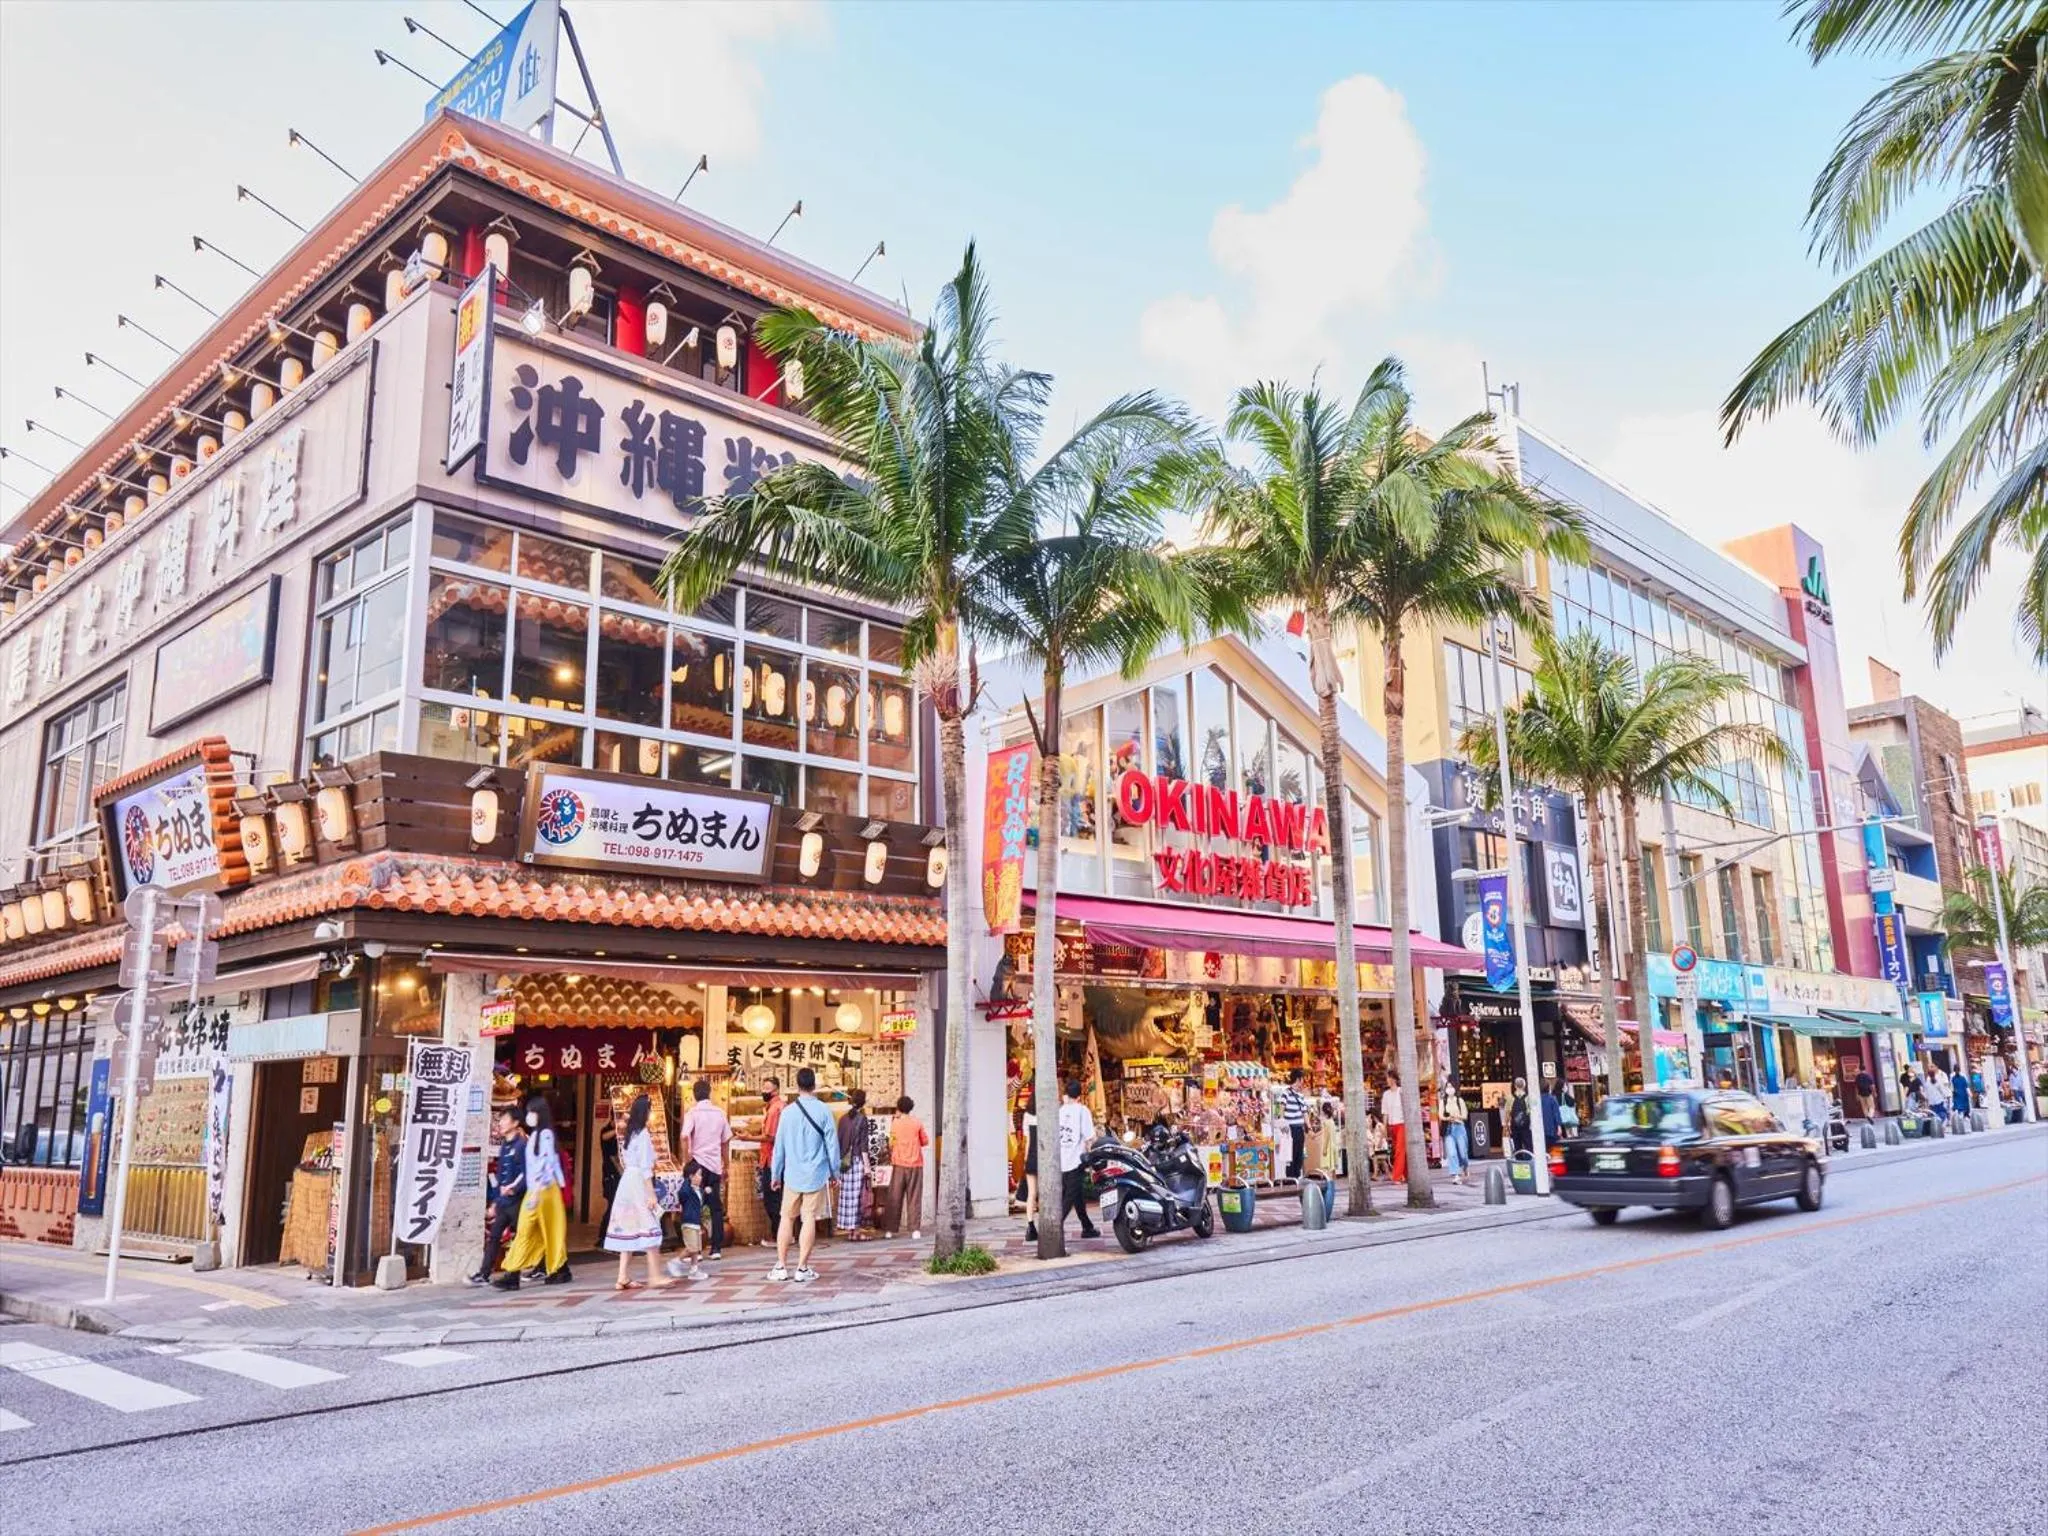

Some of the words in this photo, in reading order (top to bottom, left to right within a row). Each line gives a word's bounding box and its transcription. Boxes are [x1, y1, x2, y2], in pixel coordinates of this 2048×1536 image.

[588, 822, 629, 835] 沖縄料理
[590, 807, 619, 822] 島唄と
[632, 802, 760, 852] ちぬまん
[1000, 752, 1029, 860] OKINAWA
[1115, 769, 1330, 855] OKINAWA
[1153, 844, 1312, 907] 文化屋雑貨店
[418, 1048, 470, 1083] 無料
[407, 1085, 458, 1240] 島唄ライブ
